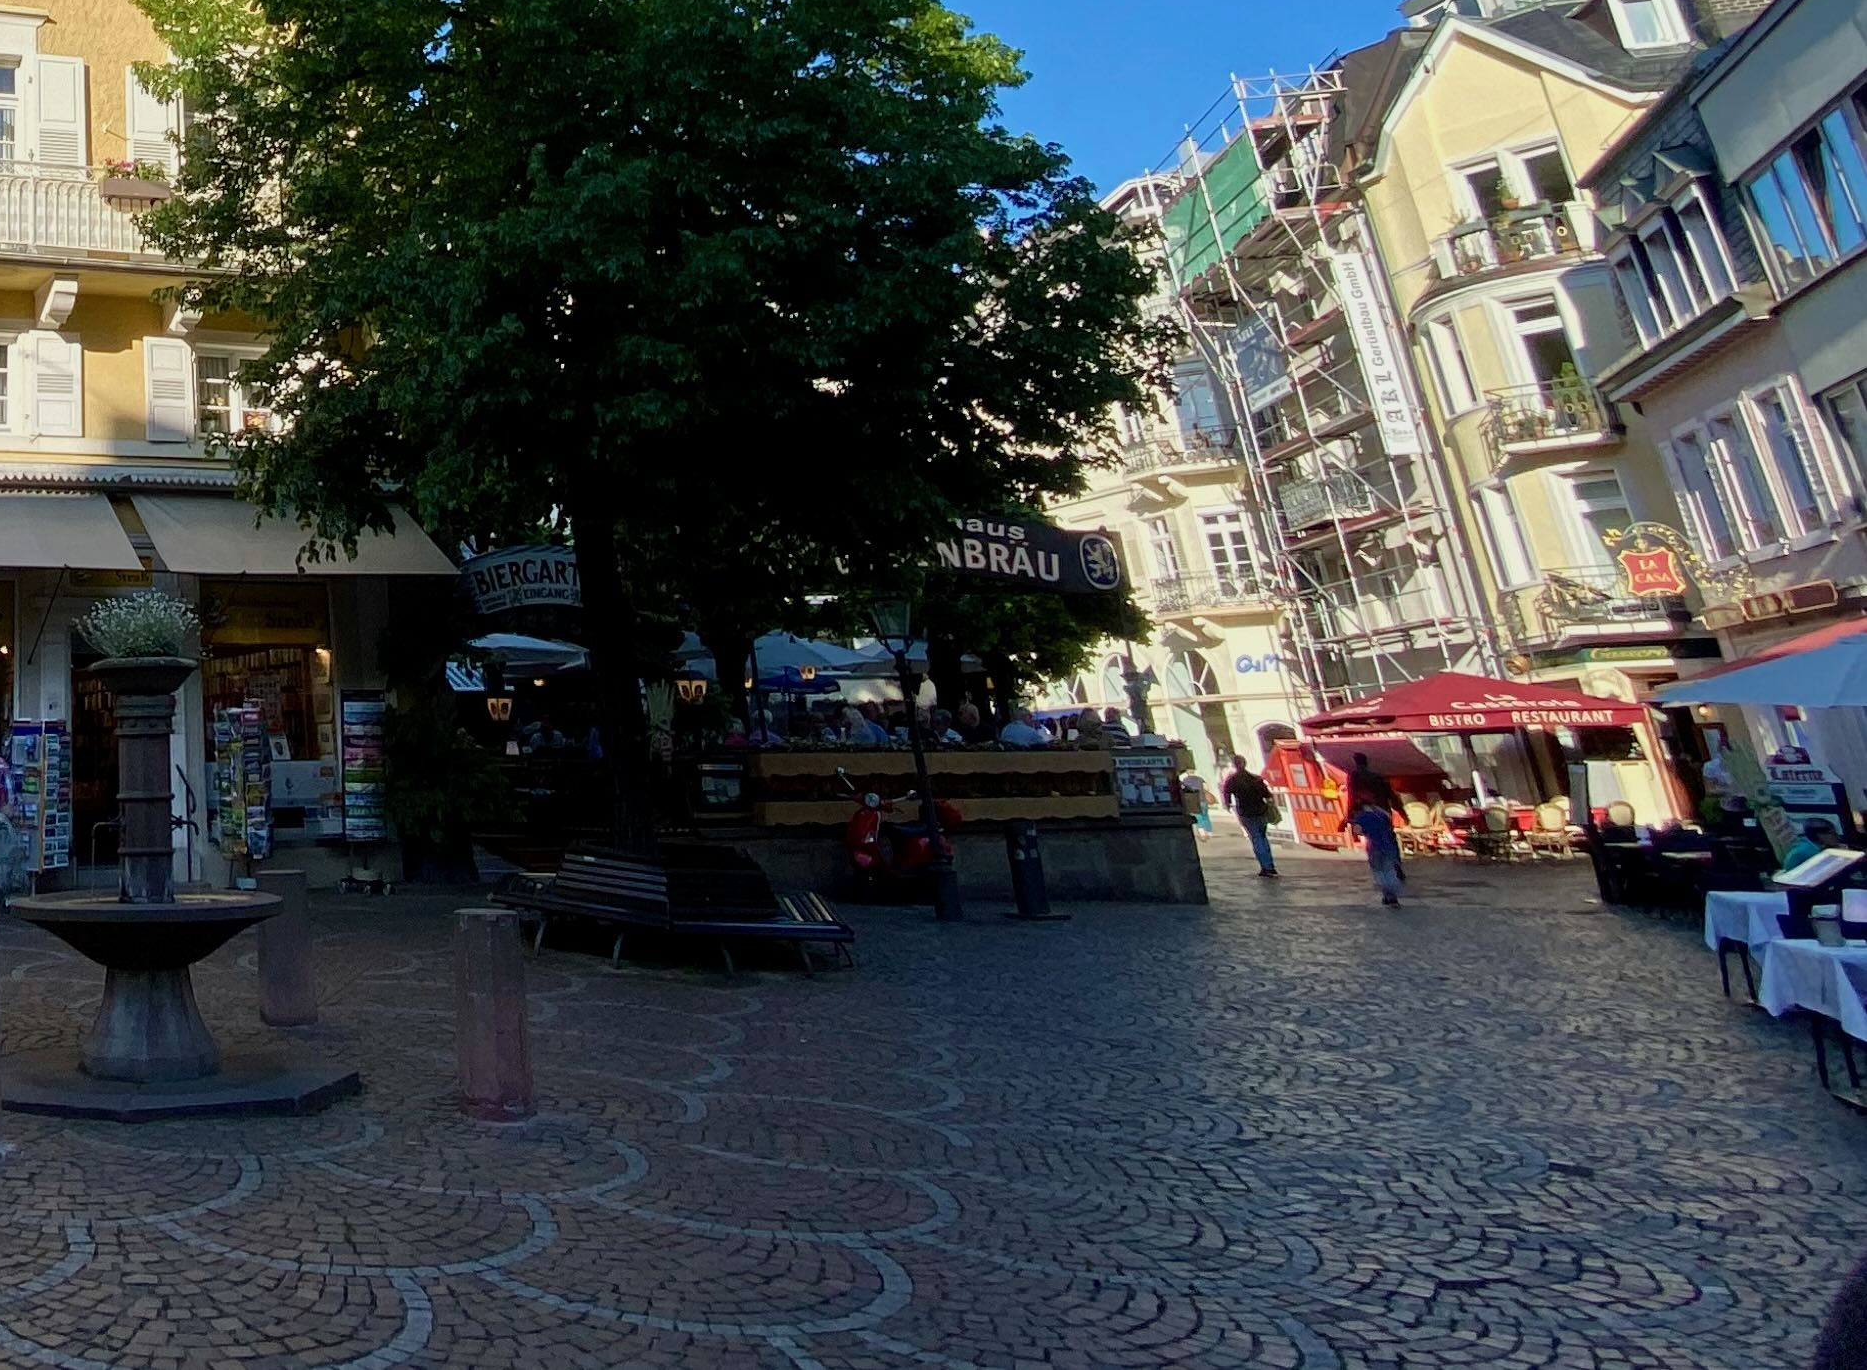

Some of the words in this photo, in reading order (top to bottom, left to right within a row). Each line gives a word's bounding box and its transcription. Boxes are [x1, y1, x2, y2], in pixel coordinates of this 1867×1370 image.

[1342, 261, 1364, 299] GmbH
[1357, 301, 1385, 366] Gerüstbau
[936, 537, 1060, 582] NBRÄU
[1638, 560, 1659, 571] LA
[473, 559, 578, 596] BIERGART
[1634, 573, 1674, 584] CASA
[1428, 713, 1485, 727] BISTRO
[1511, 710, 1613, 724] RESTAURANT
[1766, 766, 1825, 781] Laterne
